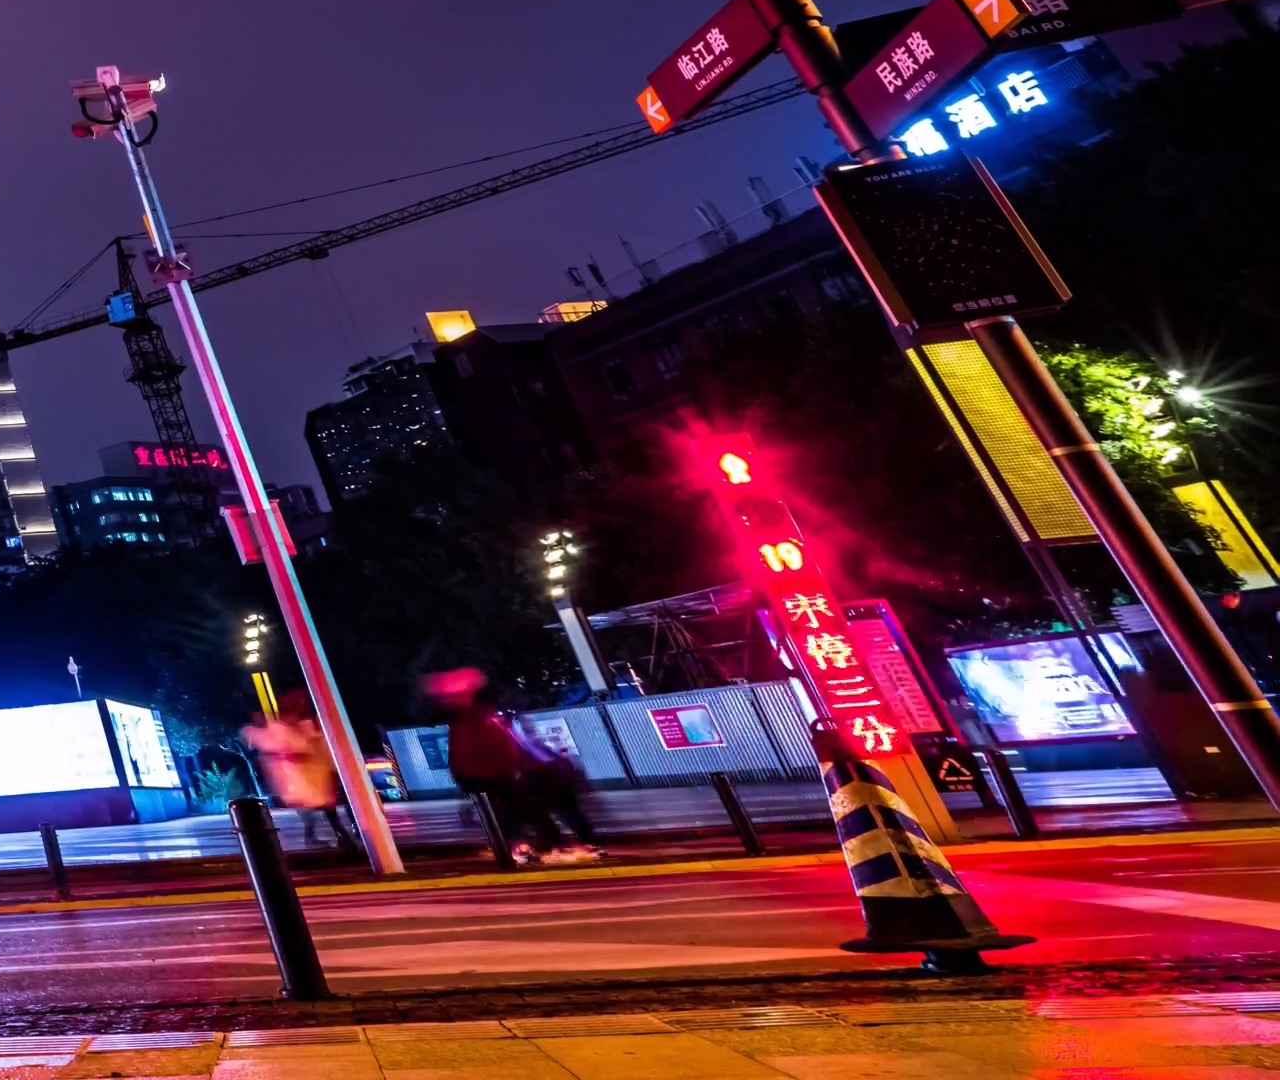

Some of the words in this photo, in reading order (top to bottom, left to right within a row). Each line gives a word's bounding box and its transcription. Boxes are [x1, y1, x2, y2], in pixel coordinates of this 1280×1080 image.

[677, 27, 729, 80] 临江路
[875, 31, 934, 93] 民族路
[695, 64, 724, 91] LINJIANG
[904, 79, 926, 101] MINZU
[863, 174, 889, 183] YOU
[891, 169, 914, 179] ARE
[759, 542, 803, 572] 19
